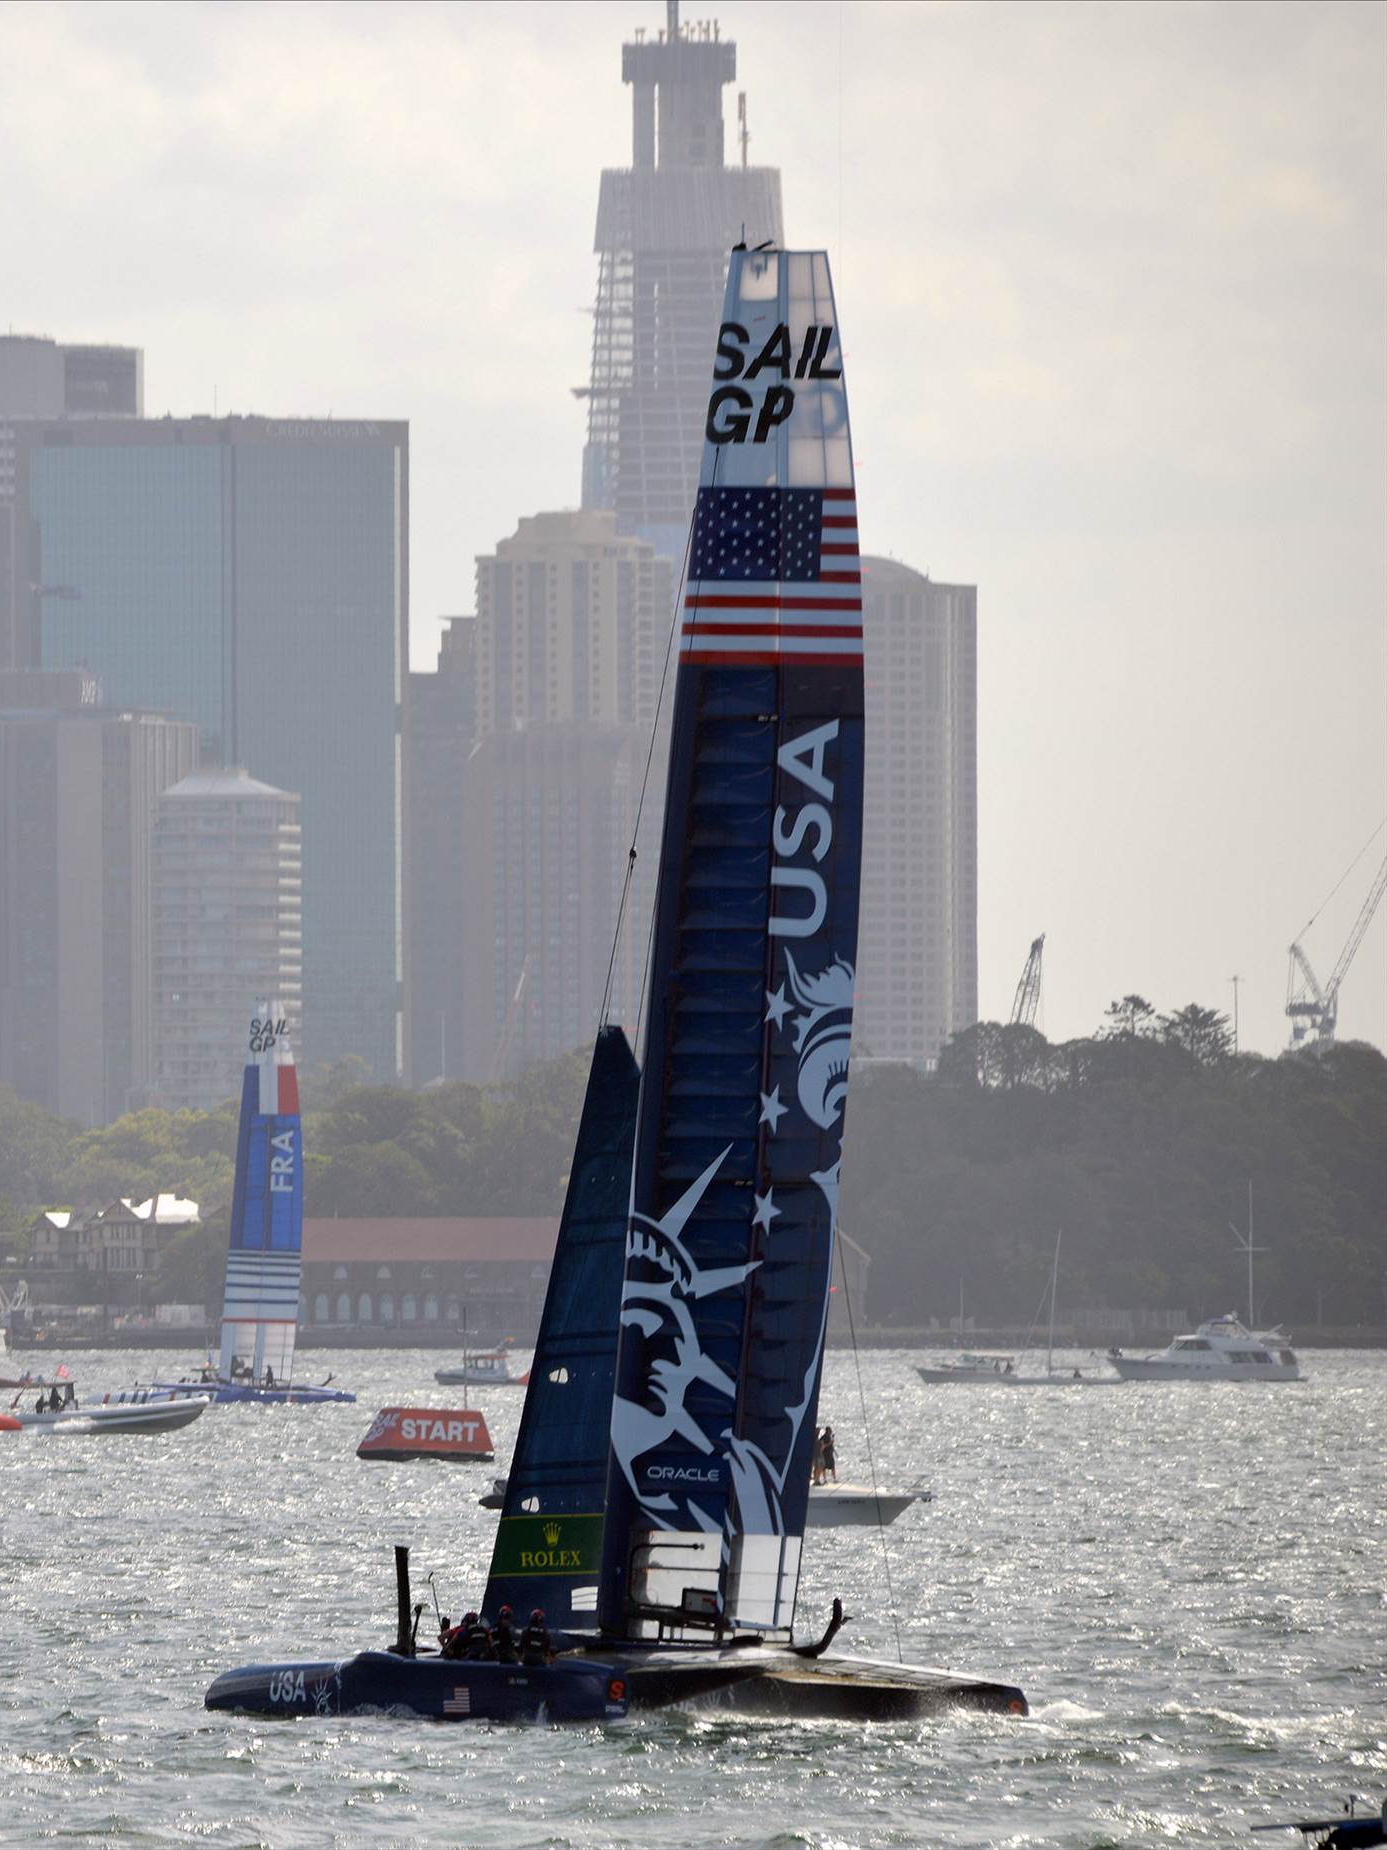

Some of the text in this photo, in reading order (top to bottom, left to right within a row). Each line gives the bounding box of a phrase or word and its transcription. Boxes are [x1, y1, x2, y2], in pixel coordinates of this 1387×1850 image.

[713, 322, 843, 380] SAIL
[705, 384, 795, 444] GP
[768, 717, 840, 938] USA
[249, 1019, 290, 1036] SAIL
[249, 1035, 276, 1053] GP
[270, 1130, 294, 1192] FRA
[401, 1418, 480, 1442] START
[647, 1466, 720, 1482] ORACLE
[520, 1550, 582, 1568] ROLEX
[269, 1669, 307, 1703] USA
